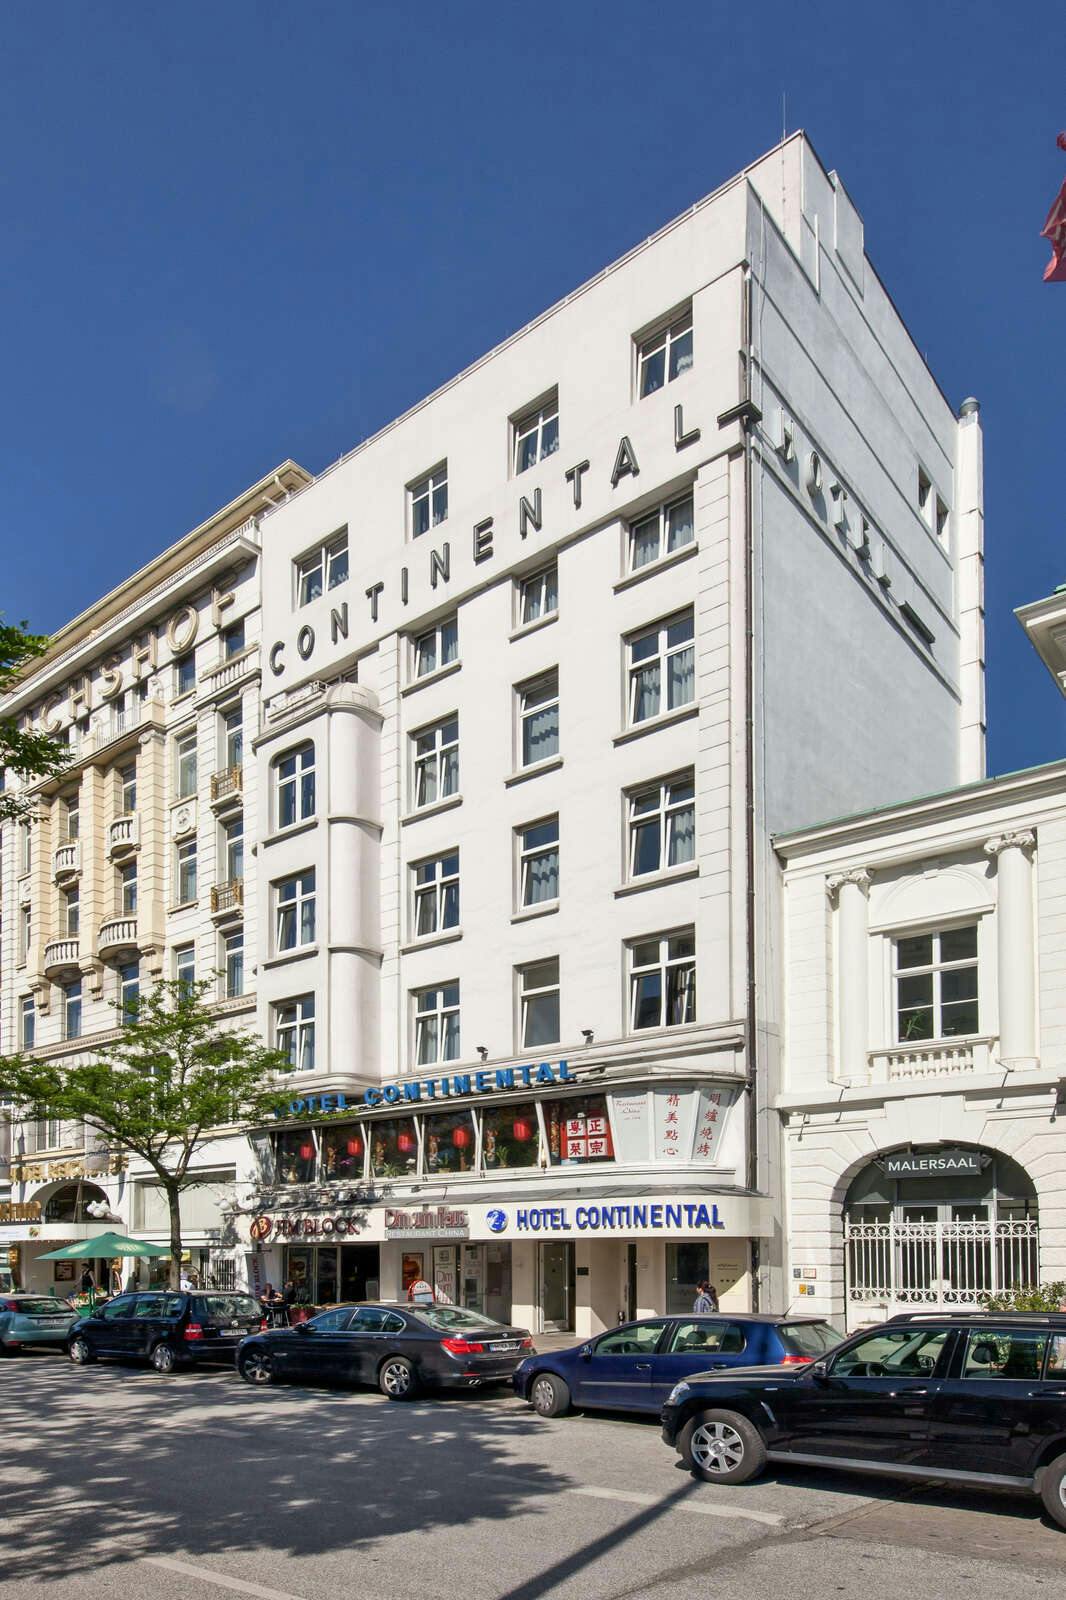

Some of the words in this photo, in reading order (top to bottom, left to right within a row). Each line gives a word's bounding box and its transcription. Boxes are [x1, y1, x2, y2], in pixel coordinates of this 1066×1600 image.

[269, 404, 700, 675] CONTINENTAL
[364, 1059, 577, 1105] CONTINENTAL
[888, 1157, 977, 1172] MALERSAAL
[274, 1219, 300, 1237] JIM
[303, 1217, 360, 1235] BLOCK
[517, 1208, 570, 1231] HOTEL
[576, 1204, 724, 1229] CONTINENTAL
[386, 1230, 436, 1238] RESTAURANT
[438, 1229, 464, 1238] CHINA
